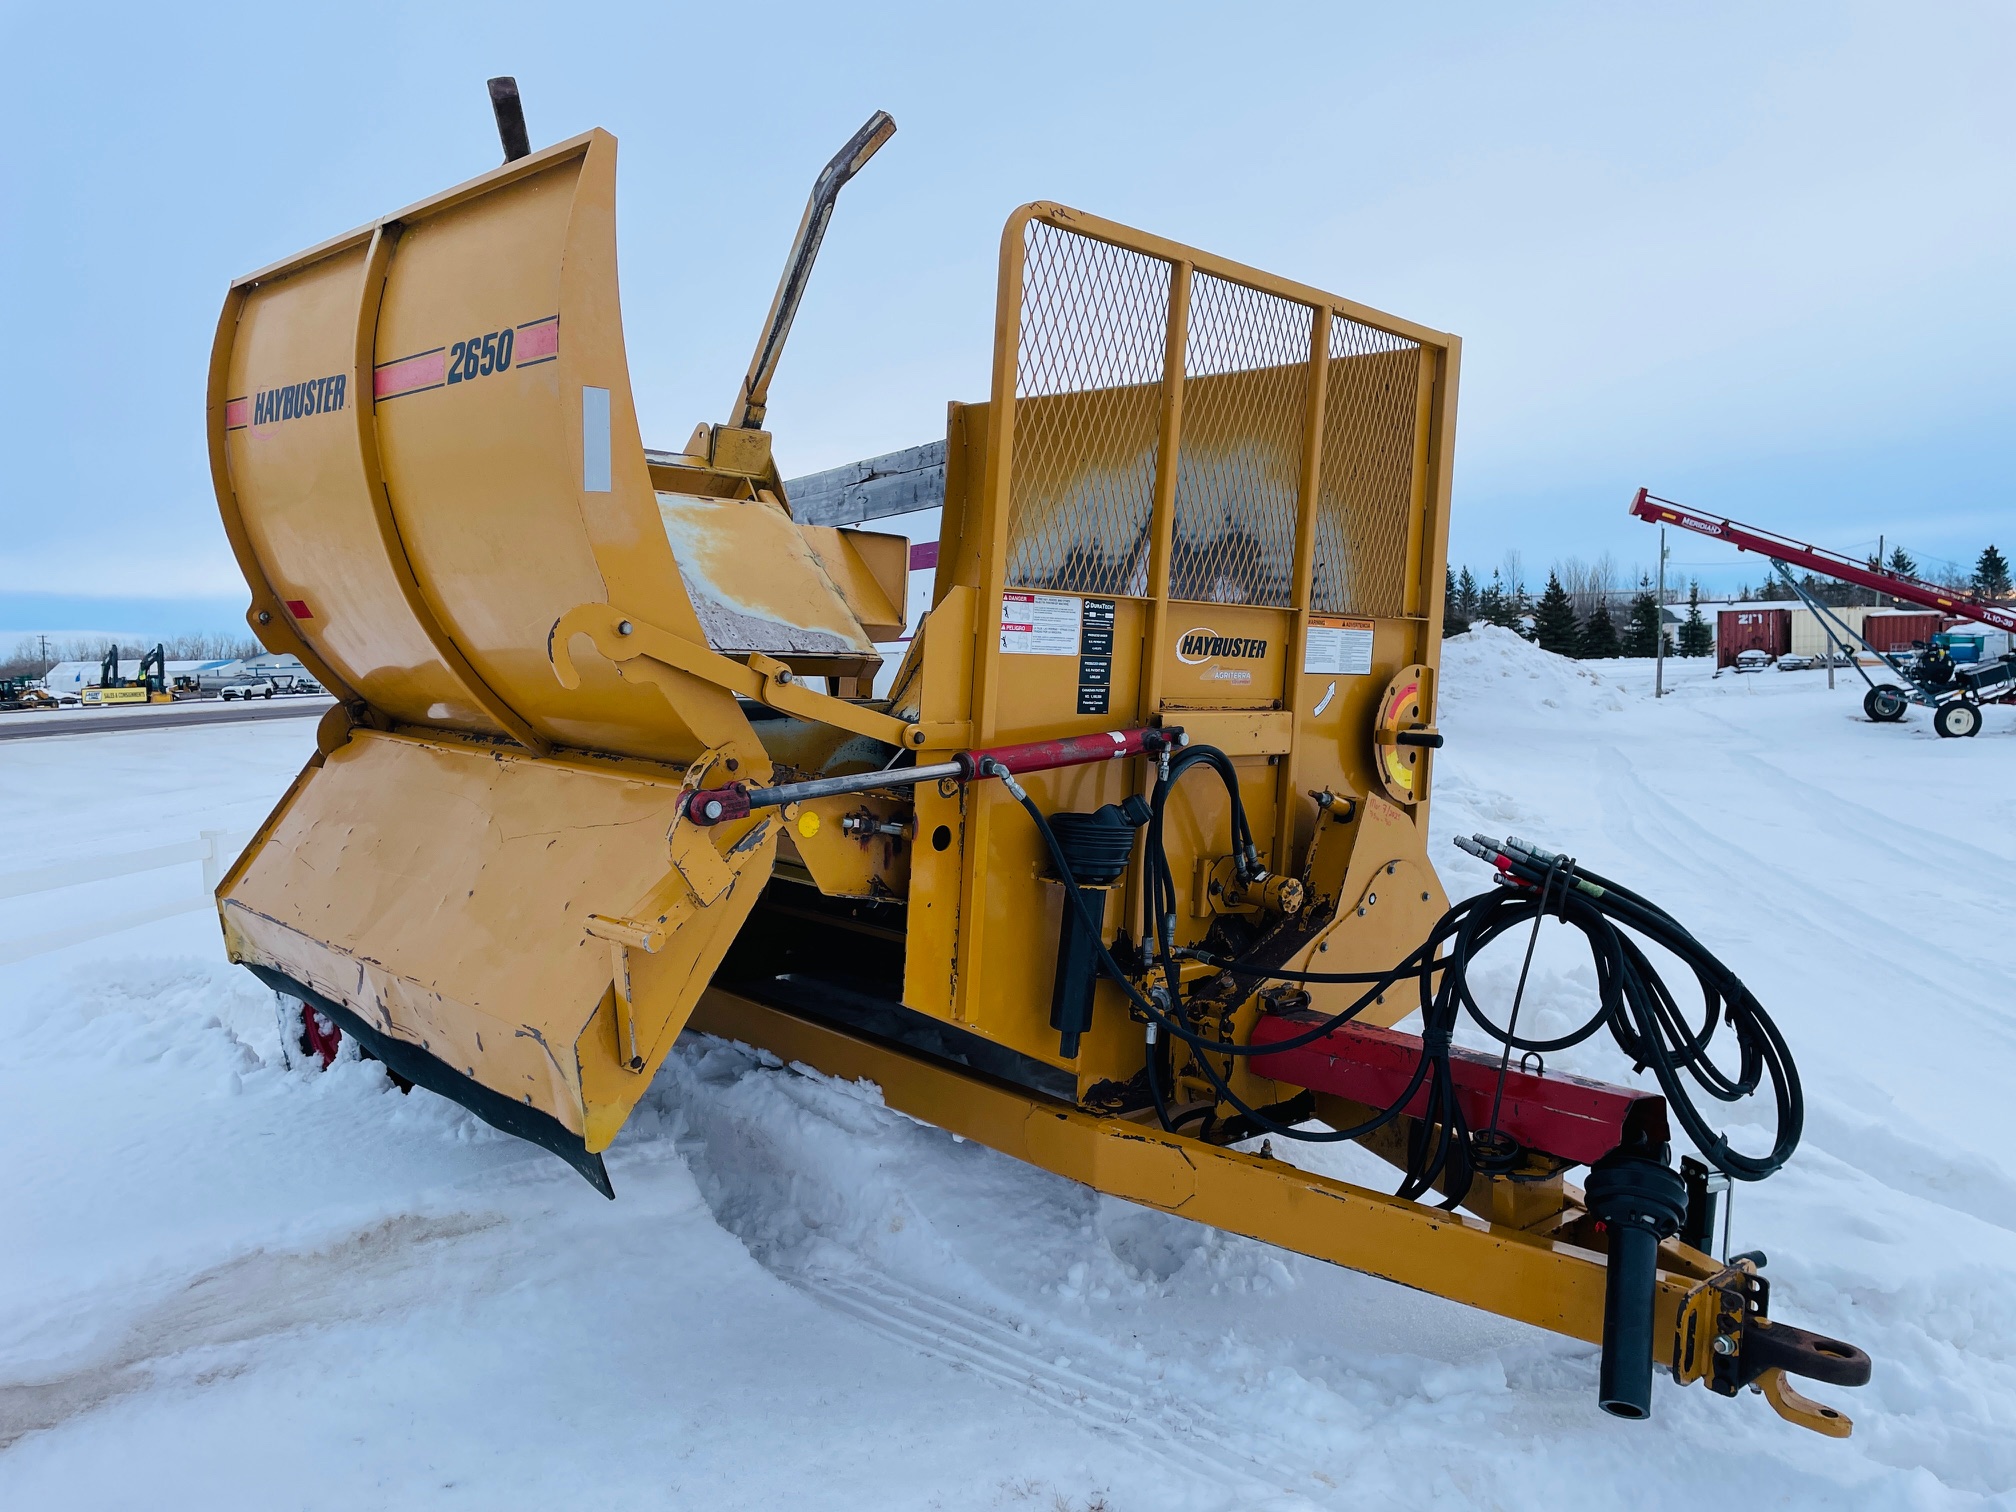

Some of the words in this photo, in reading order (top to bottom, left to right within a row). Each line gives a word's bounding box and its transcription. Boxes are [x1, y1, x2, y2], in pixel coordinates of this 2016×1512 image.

[447, 328, 514, 386] 2650
[253, 374, 347, 426] HAYBUSTER
[1682, 517, 1717, 533] MERIDIAN
[1983, 611, 2014, 628] TL10-39
[1181, 635, 1267, 659] HAYBUSTER
[1214, 671, 1251, 680] AGRITERRA
